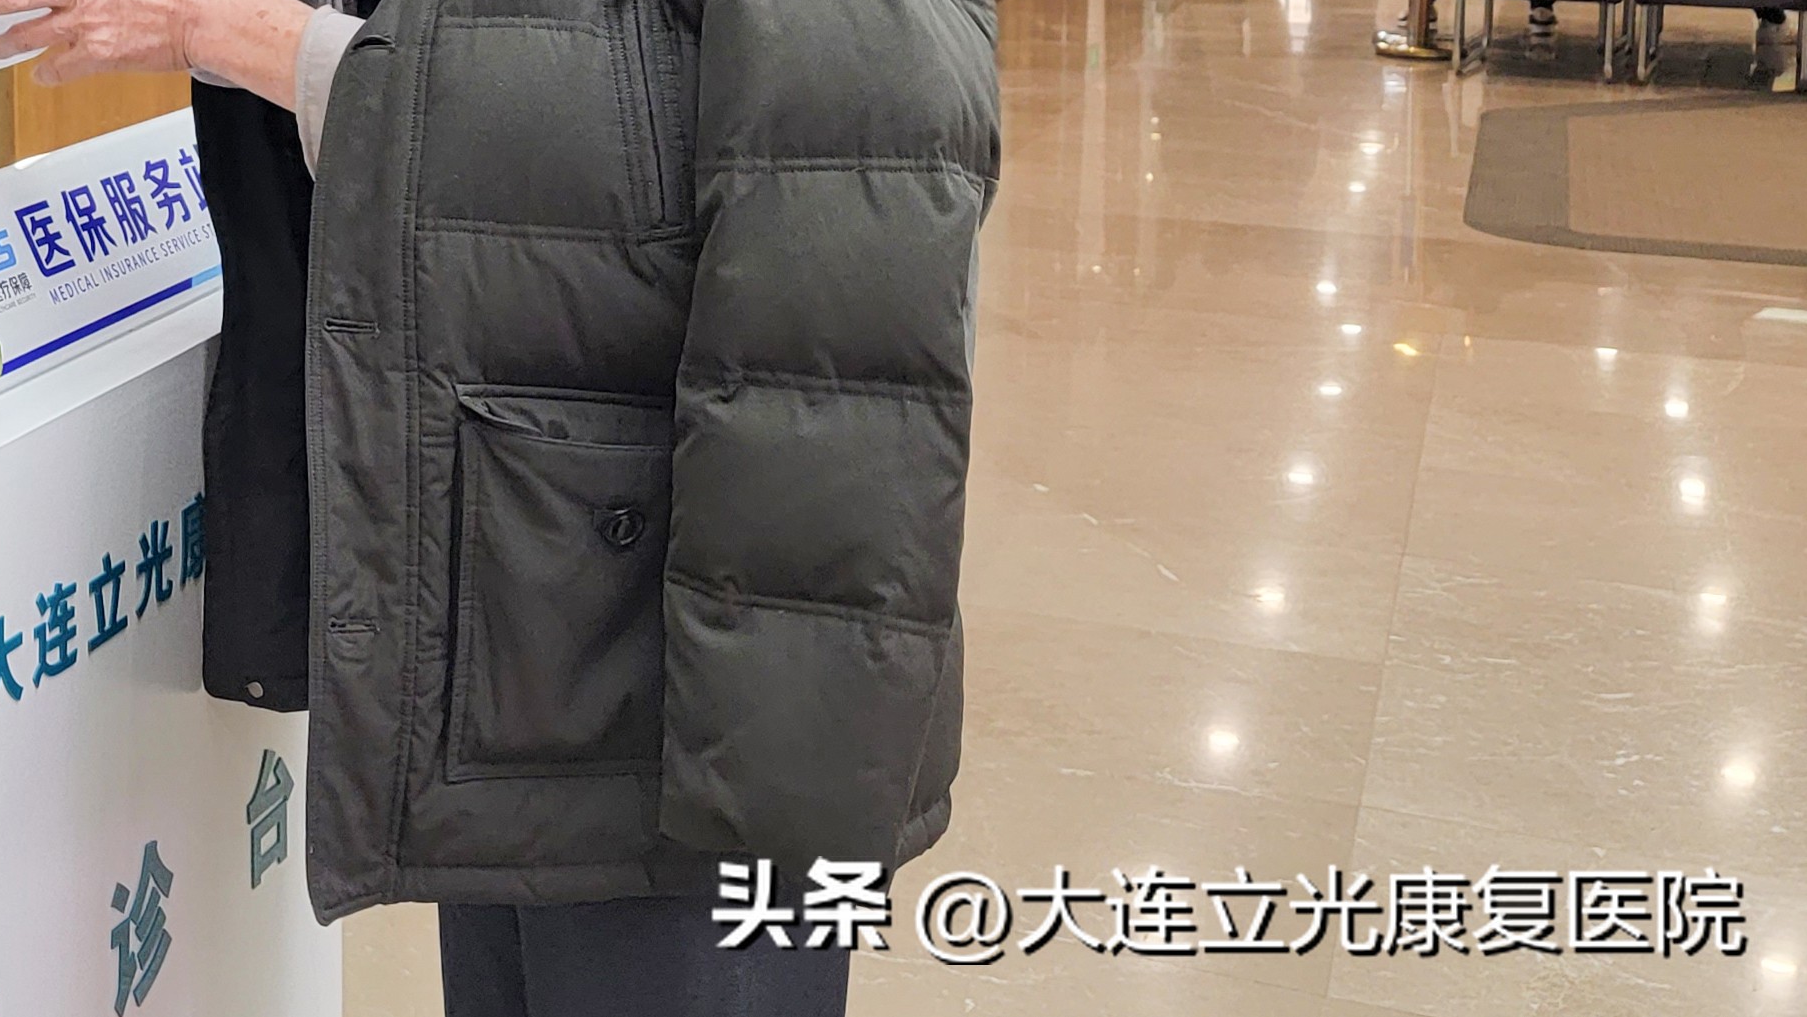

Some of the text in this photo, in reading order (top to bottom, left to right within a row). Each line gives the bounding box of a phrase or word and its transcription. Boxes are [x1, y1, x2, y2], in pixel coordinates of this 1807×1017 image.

[49, 272, 100, 305] MEDICAL
[99, 246, 161, 284] INSURANCE
[159, 228, 202, 258] SERVICE
